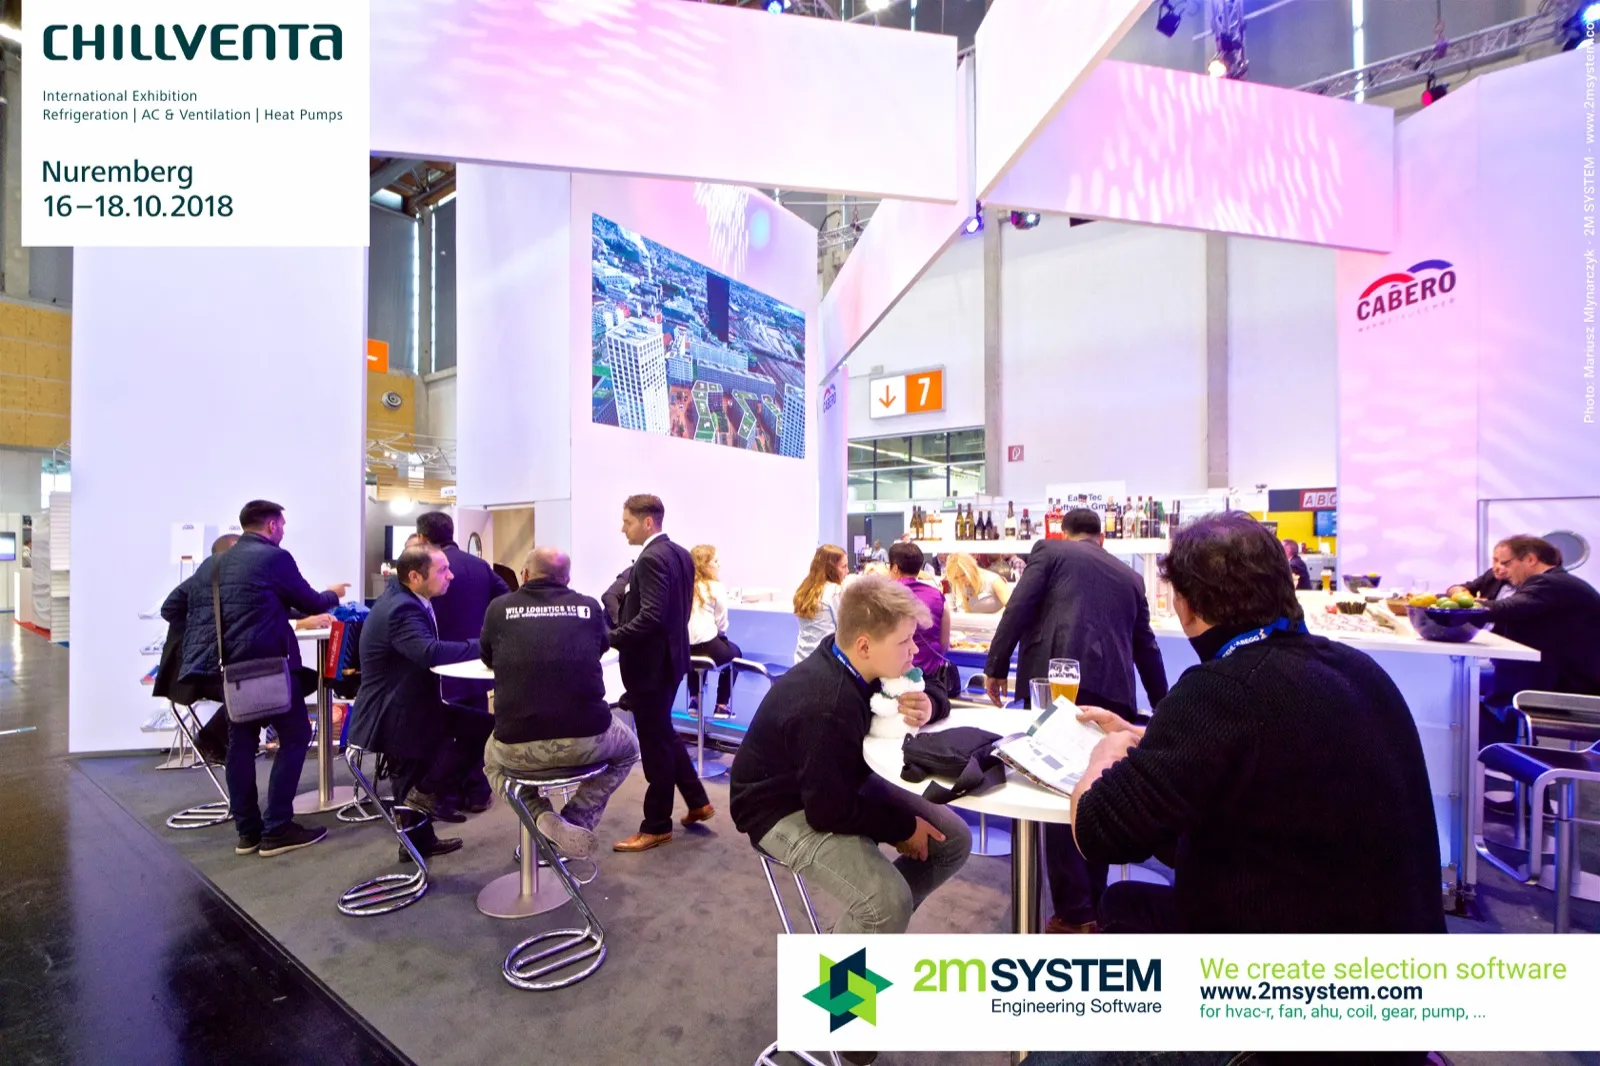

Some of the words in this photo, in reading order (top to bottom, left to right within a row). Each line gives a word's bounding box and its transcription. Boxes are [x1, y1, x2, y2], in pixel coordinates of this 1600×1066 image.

[1357, 270, 1456, 321] CABERO
[917, 376, 931, 406] 7
[505, 607, 524, 615] WILD
[526, 605, 565, 614] LOGISTICS
